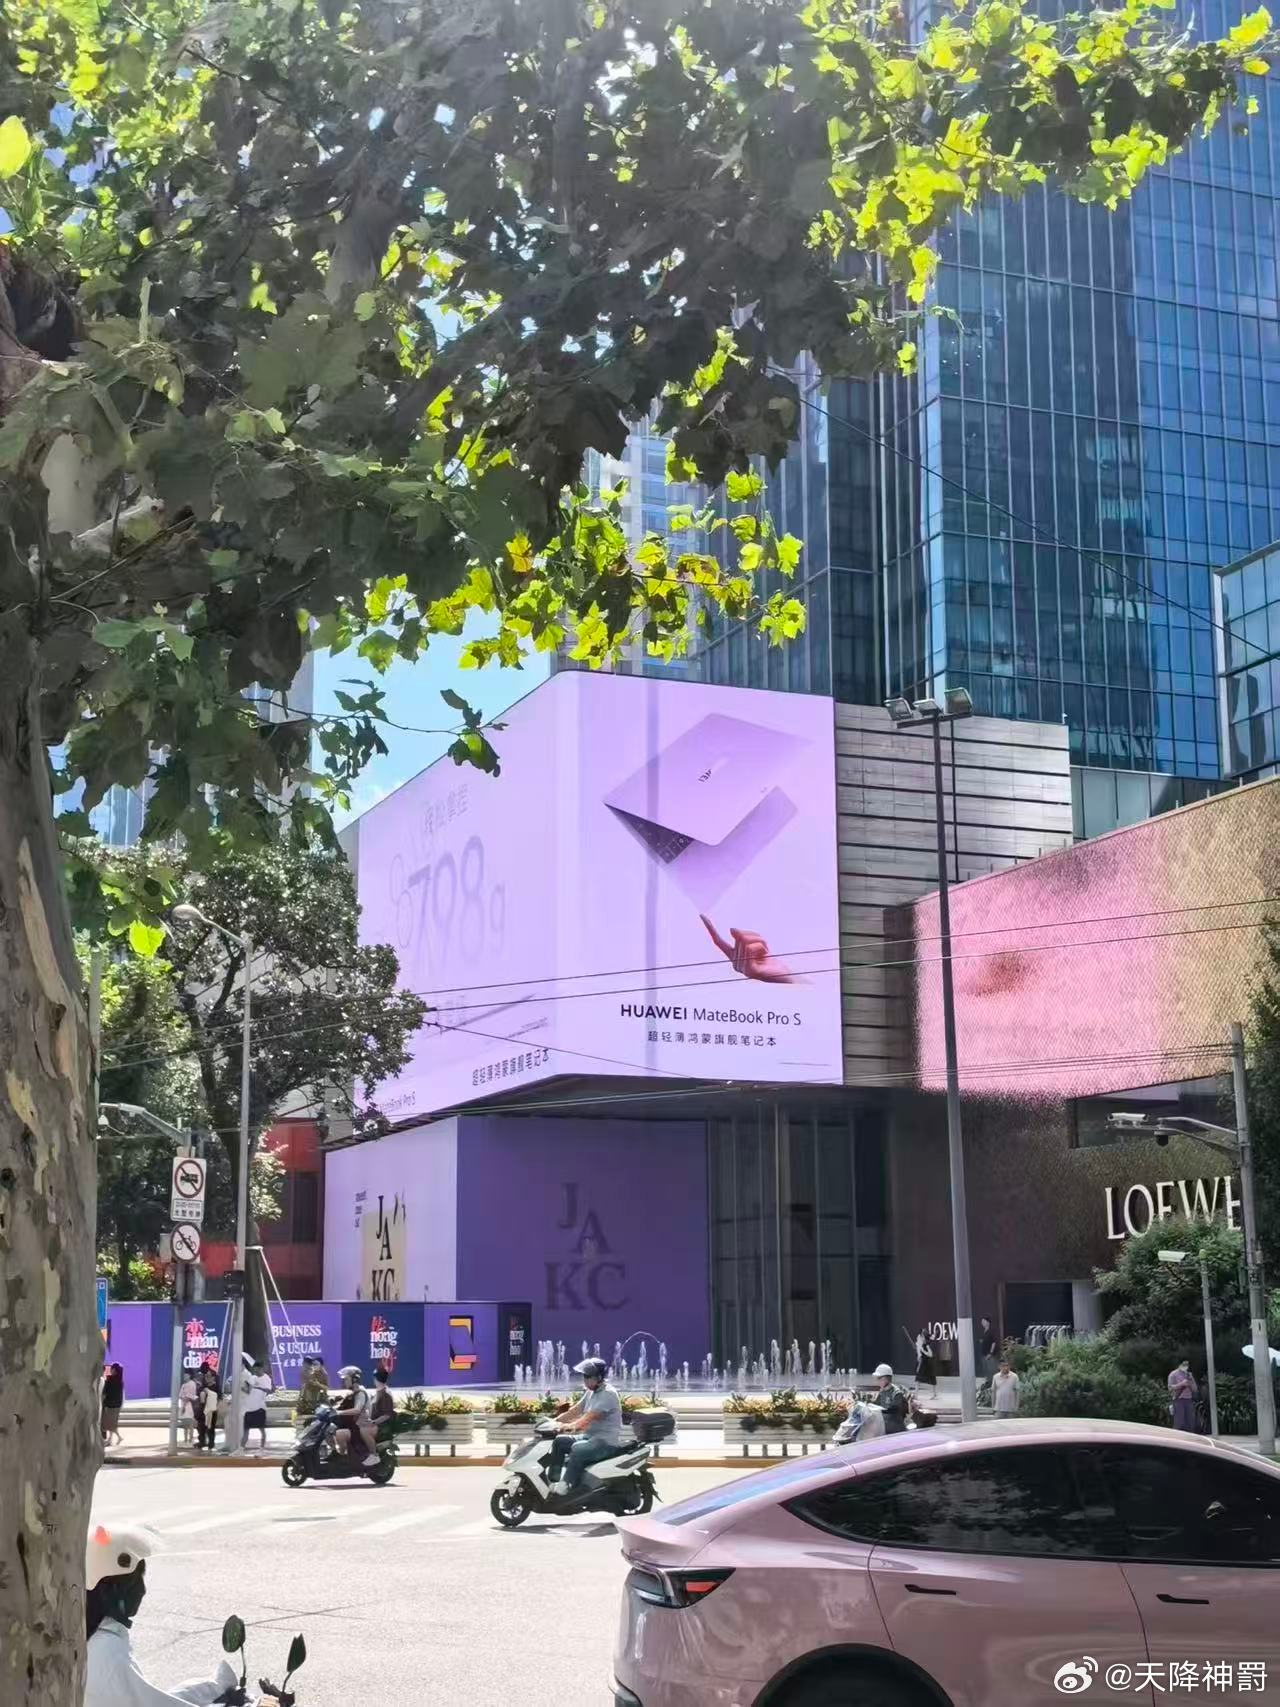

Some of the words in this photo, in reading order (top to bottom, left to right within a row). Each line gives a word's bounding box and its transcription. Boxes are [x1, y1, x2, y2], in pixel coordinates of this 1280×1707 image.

[620, 1004, 688, 1021] HUAWEI
[693, 1008, 764, 1025] MateBook
[767, 1012, 790, 1026] Pro
[793, 1013, 802, 1027] S
[647, 1030, 777, 1047] 超轻薄鸿蒙旗舰笔记本
[1105, 1176, 1242, 1240] LOEWE
[272, 1325, 322, 1339] BUSINESS
[928, 1321, 958, 1341] LOEW
[272, 1343, 285, 1355] AS
[288, 1342, 322, 1355] USUAL
